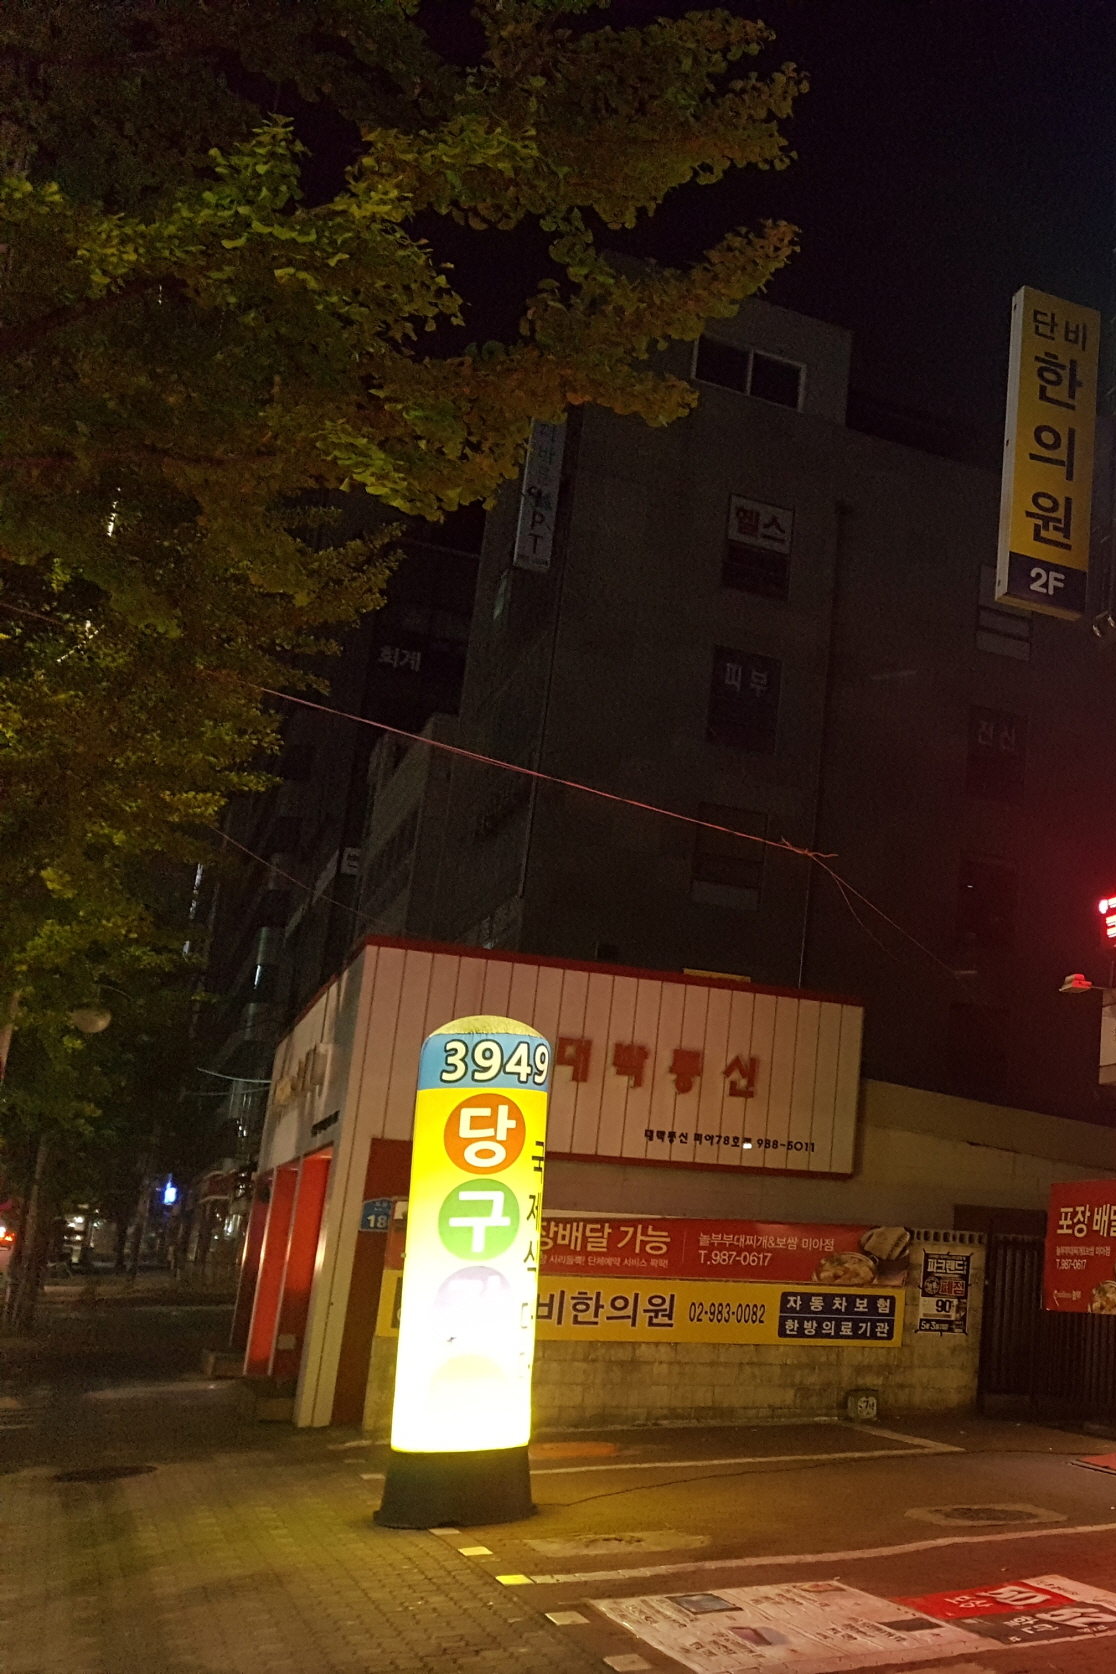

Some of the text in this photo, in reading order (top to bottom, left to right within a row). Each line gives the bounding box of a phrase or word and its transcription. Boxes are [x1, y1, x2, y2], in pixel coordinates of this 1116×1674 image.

[1033, 308, 1087, 352] 단비
[1025, 351, 1083, 552] 한의원
[1029, 567, 1066, 596] 2F
[440, 1038, 549, 1084] 3949
[367, 1214, 388, 1229] 18
[617, 1223, 671, 1255] 가능
[801, 1237, 834, 1252] 미아점
[698, 1250, 772, 1267] T.987-0617
[688, 1302, 767, 1325] 02-983-0082
